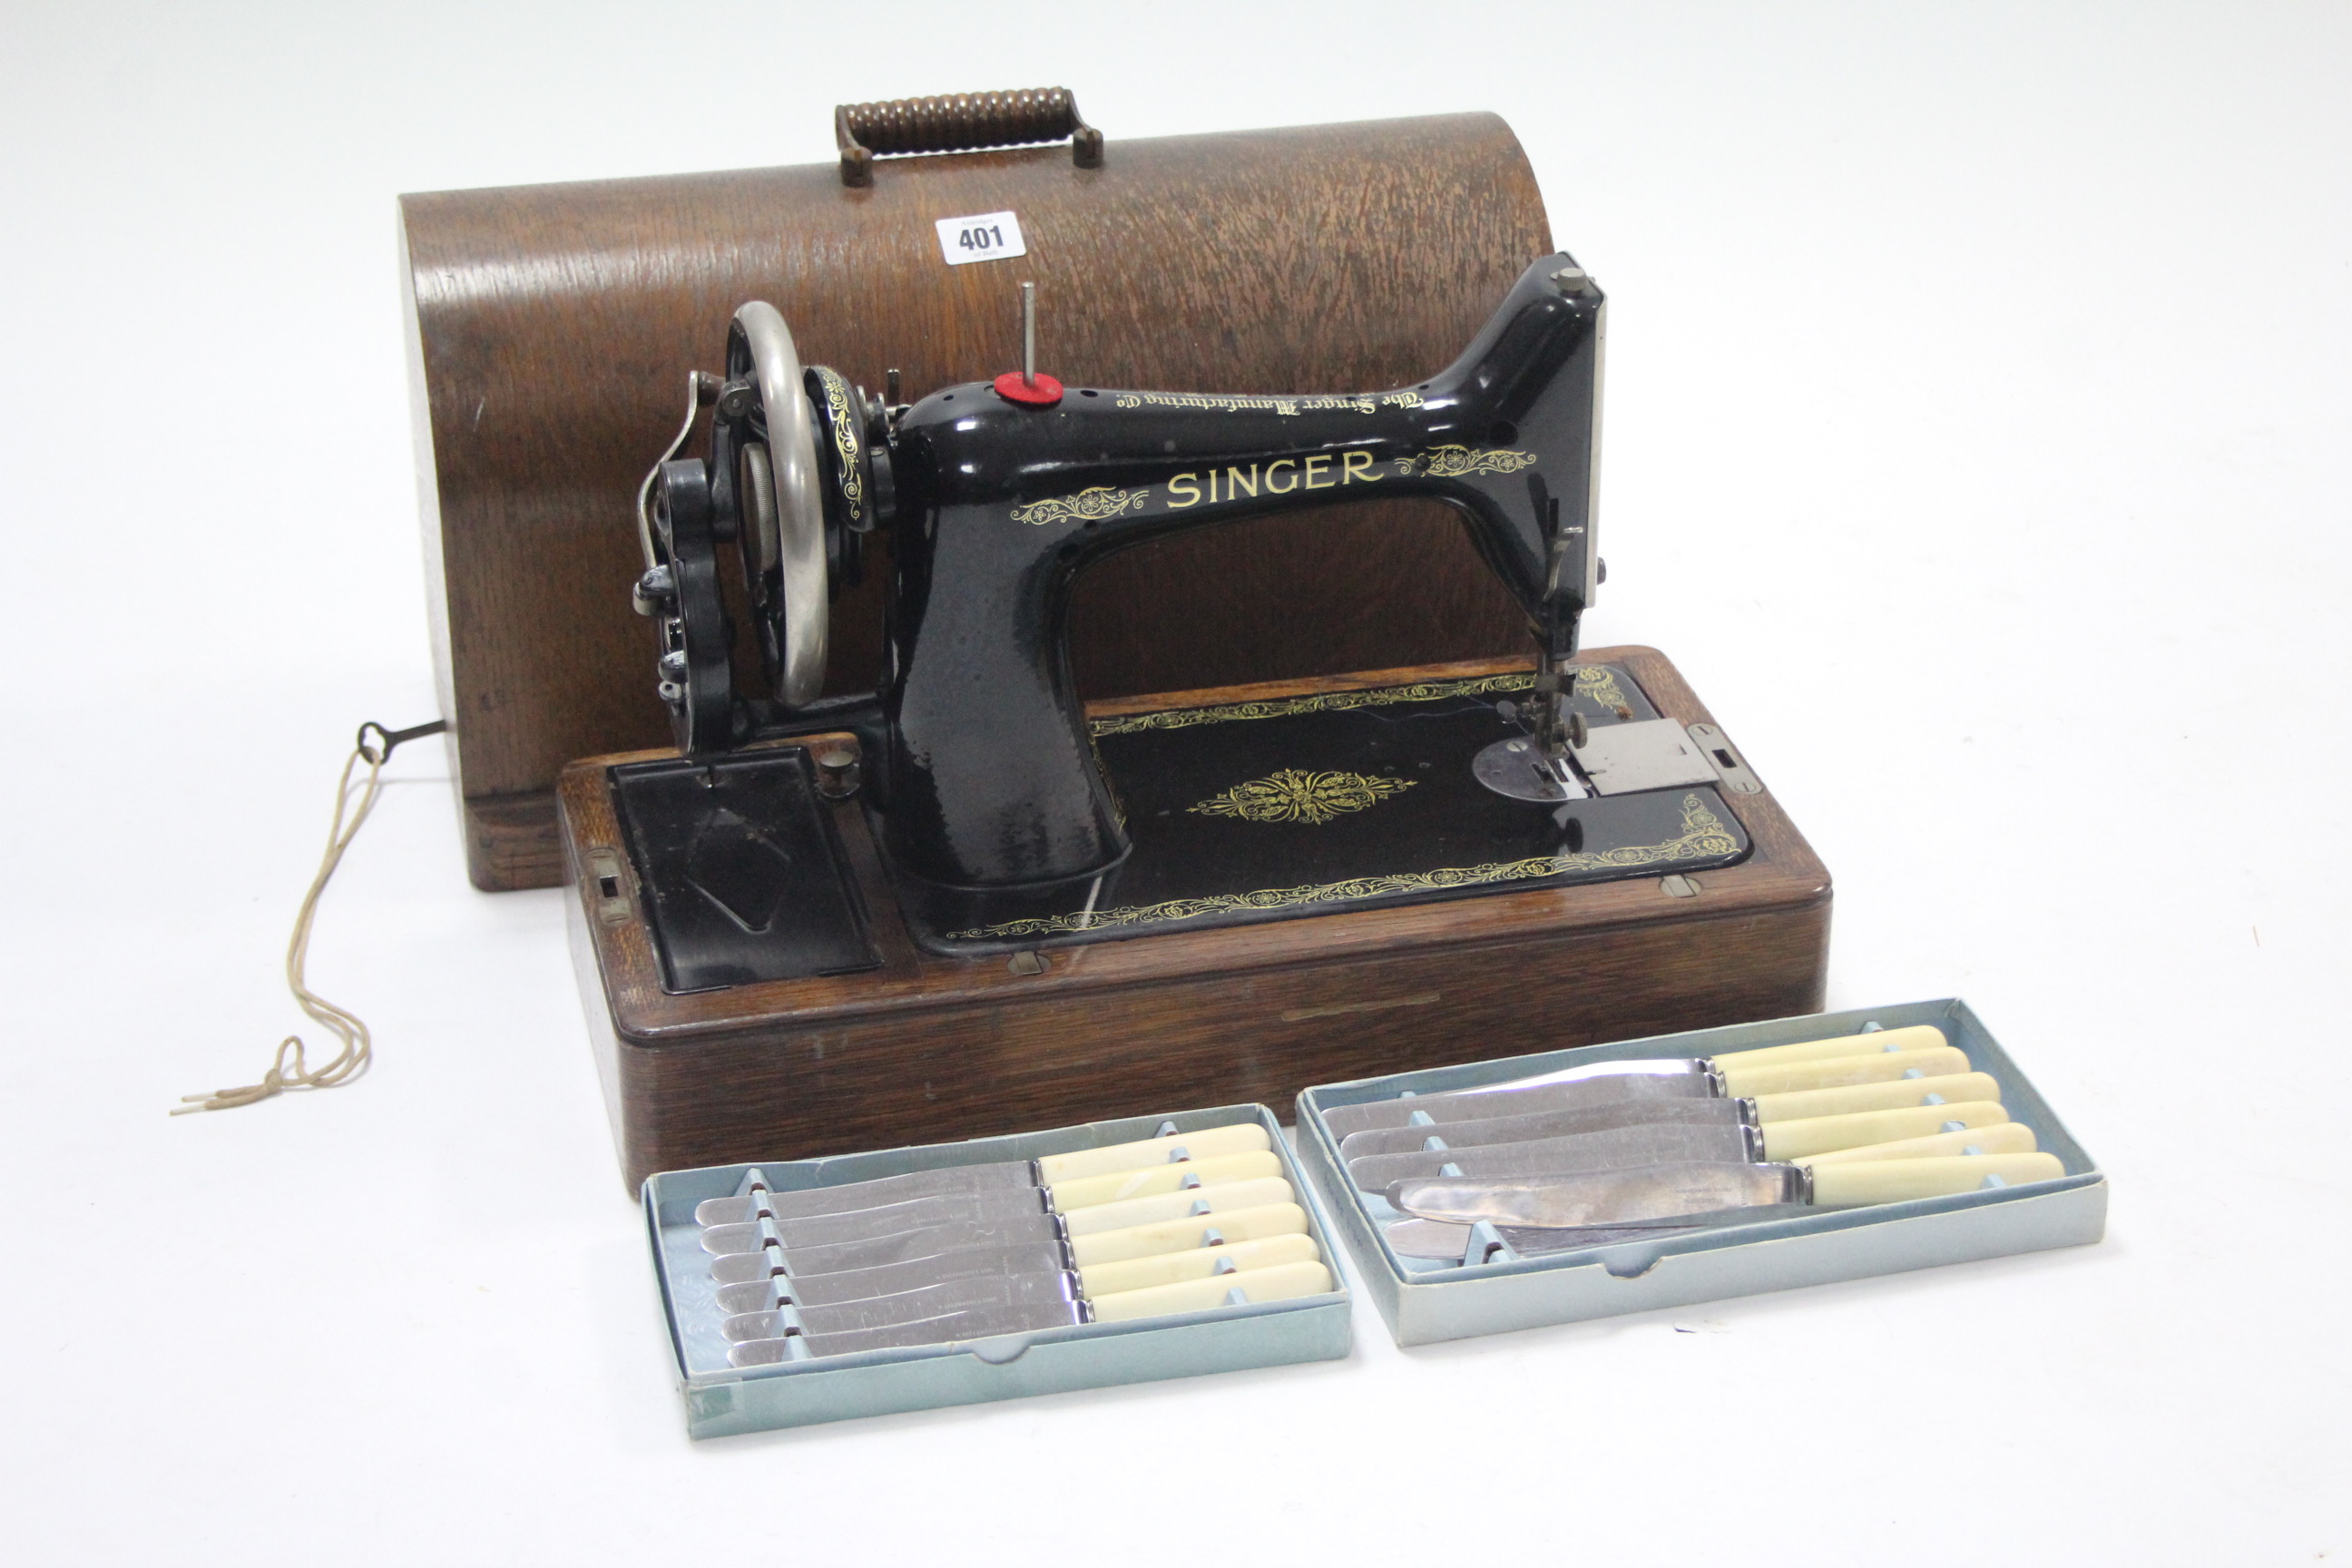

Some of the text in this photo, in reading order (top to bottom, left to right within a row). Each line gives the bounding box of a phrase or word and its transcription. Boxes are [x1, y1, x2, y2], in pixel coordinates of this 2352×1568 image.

[959, 225, 1004, 250] 401
[1143, 394, 1301, 416] Manufacturing
[1302, 397, 1376, 414] Singer
[1381, 392, 1424, 409] The
[1167, 451, 1385, 508] SINGER
